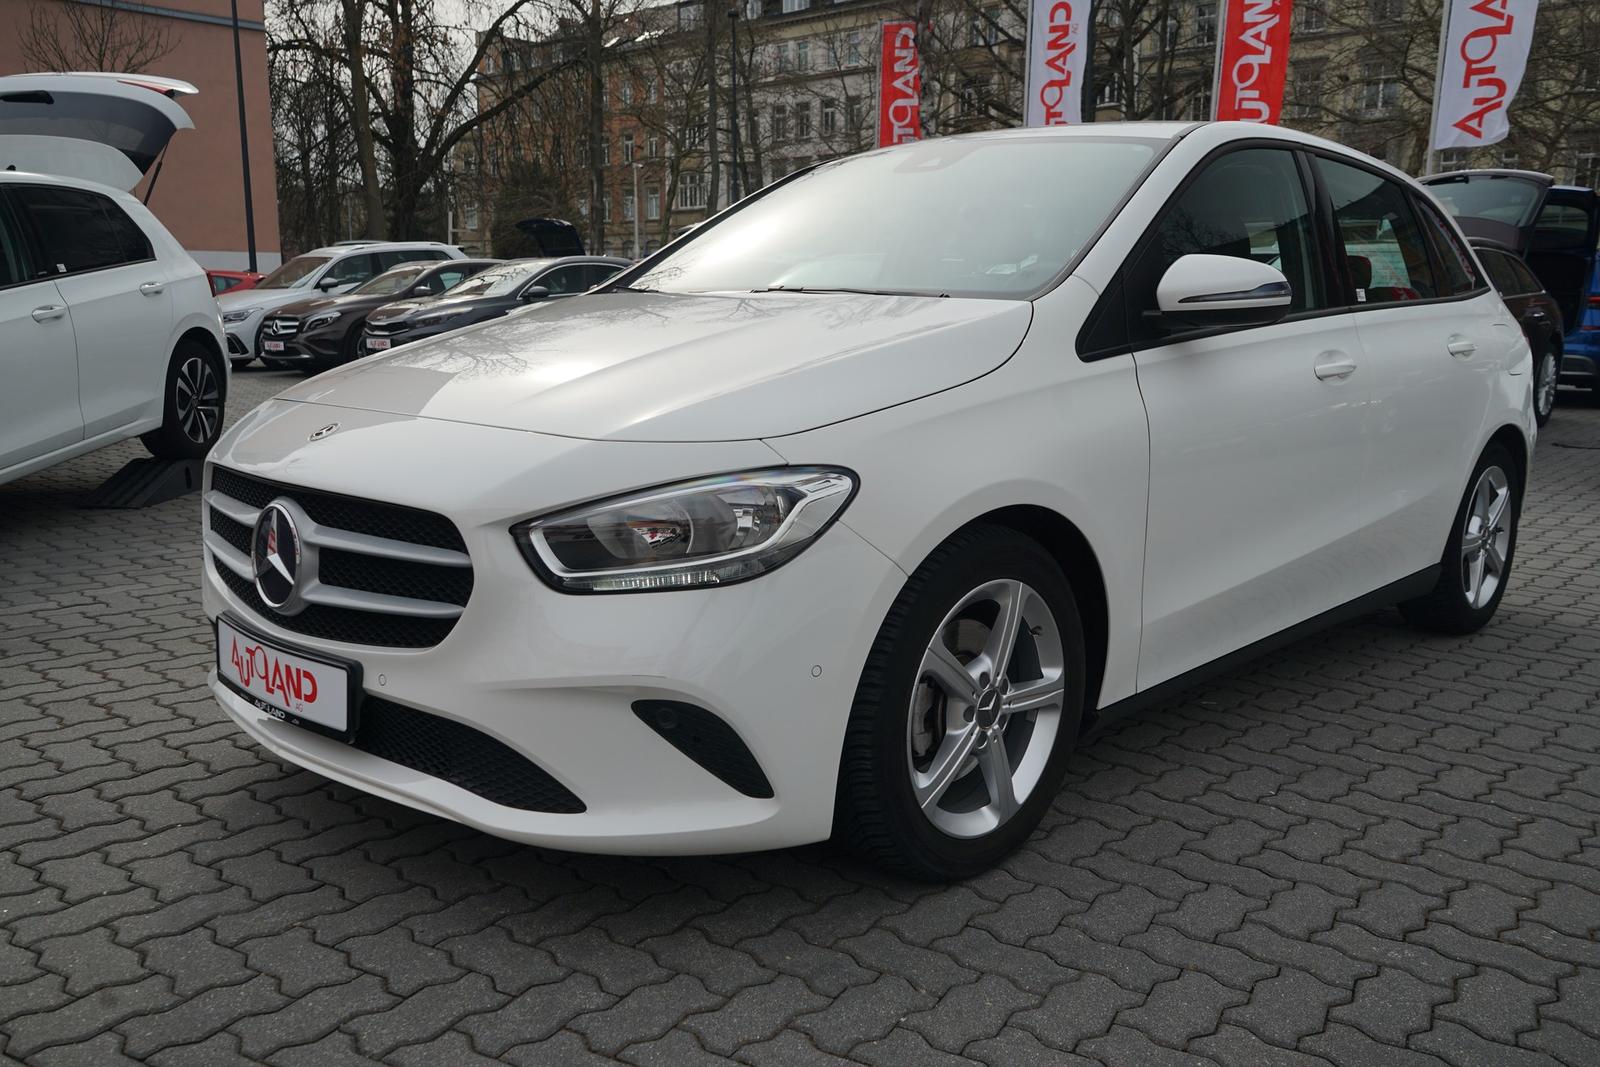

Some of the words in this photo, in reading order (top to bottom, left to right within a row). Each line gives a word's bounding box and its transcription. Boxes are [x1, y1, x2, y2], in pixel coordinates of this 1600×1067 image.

[888, 27, 919, 143] TOLAND
[1040, 2, 1077, 126] TOLAND
[1232, 0, 1279, 124] UTOLAN
[1452, 0, 1514, 139] AUTOLA
[231, 635, 318, 707] AUTOLAND
